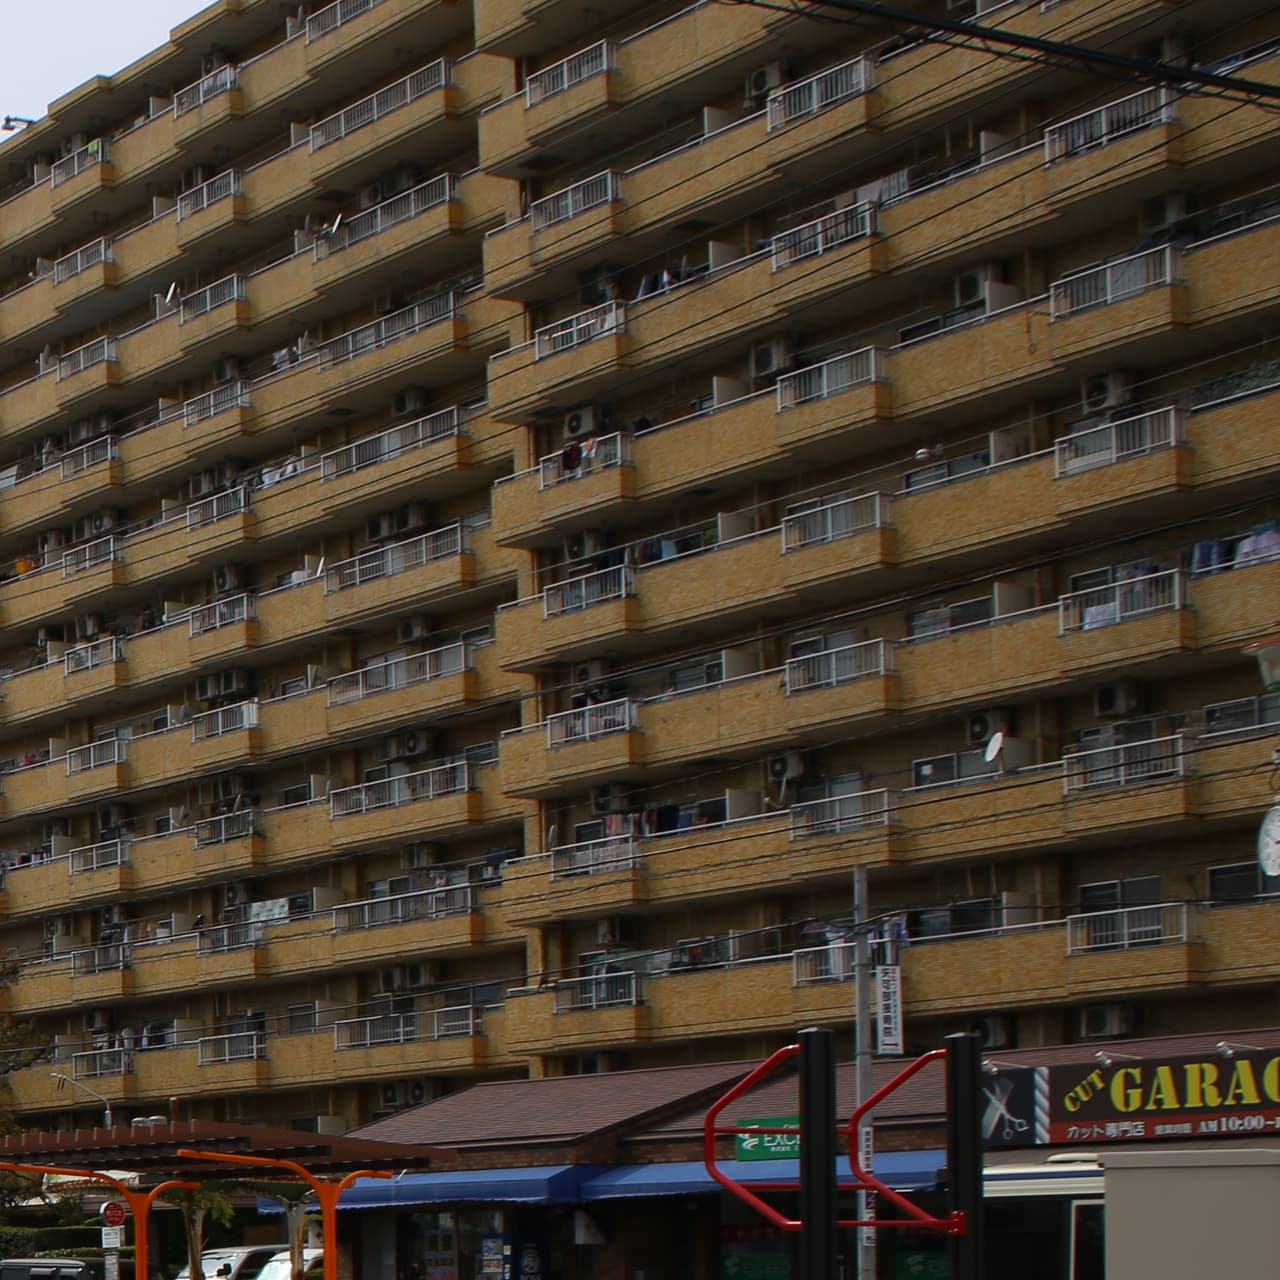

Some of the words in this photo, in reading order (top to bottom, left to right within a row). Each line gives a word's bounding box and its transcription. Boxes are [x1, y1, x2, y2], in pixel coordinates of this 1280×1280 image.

[1064, 1068, 1106, 1112] CUT
[1066, 1121, 1145, 1139] カット専門店
